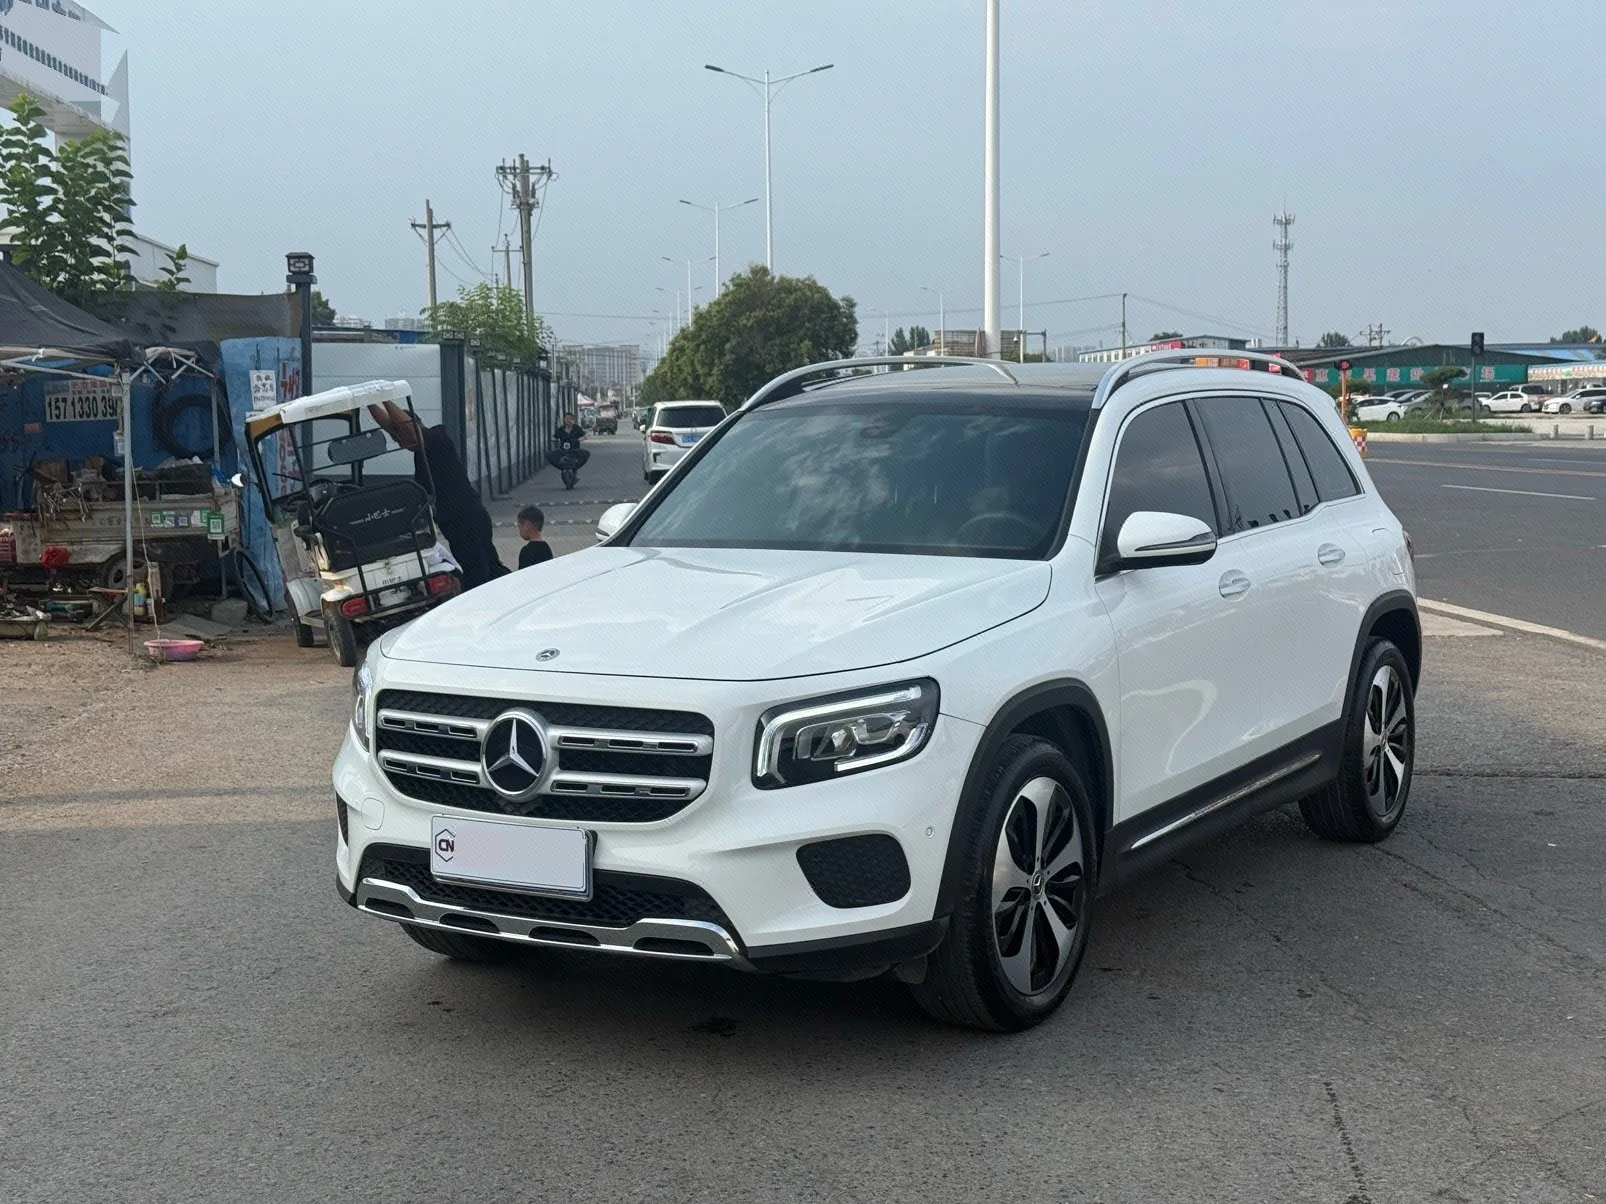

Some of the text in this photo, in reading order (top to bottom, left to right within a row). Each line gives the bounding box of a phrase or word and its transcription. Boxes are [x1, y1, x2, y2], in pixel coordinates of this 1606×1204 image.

[47, 397, 68, 420] 157
[71, 396, 98, 419] 1330
[365, 508, 391, 522] 小巴士
